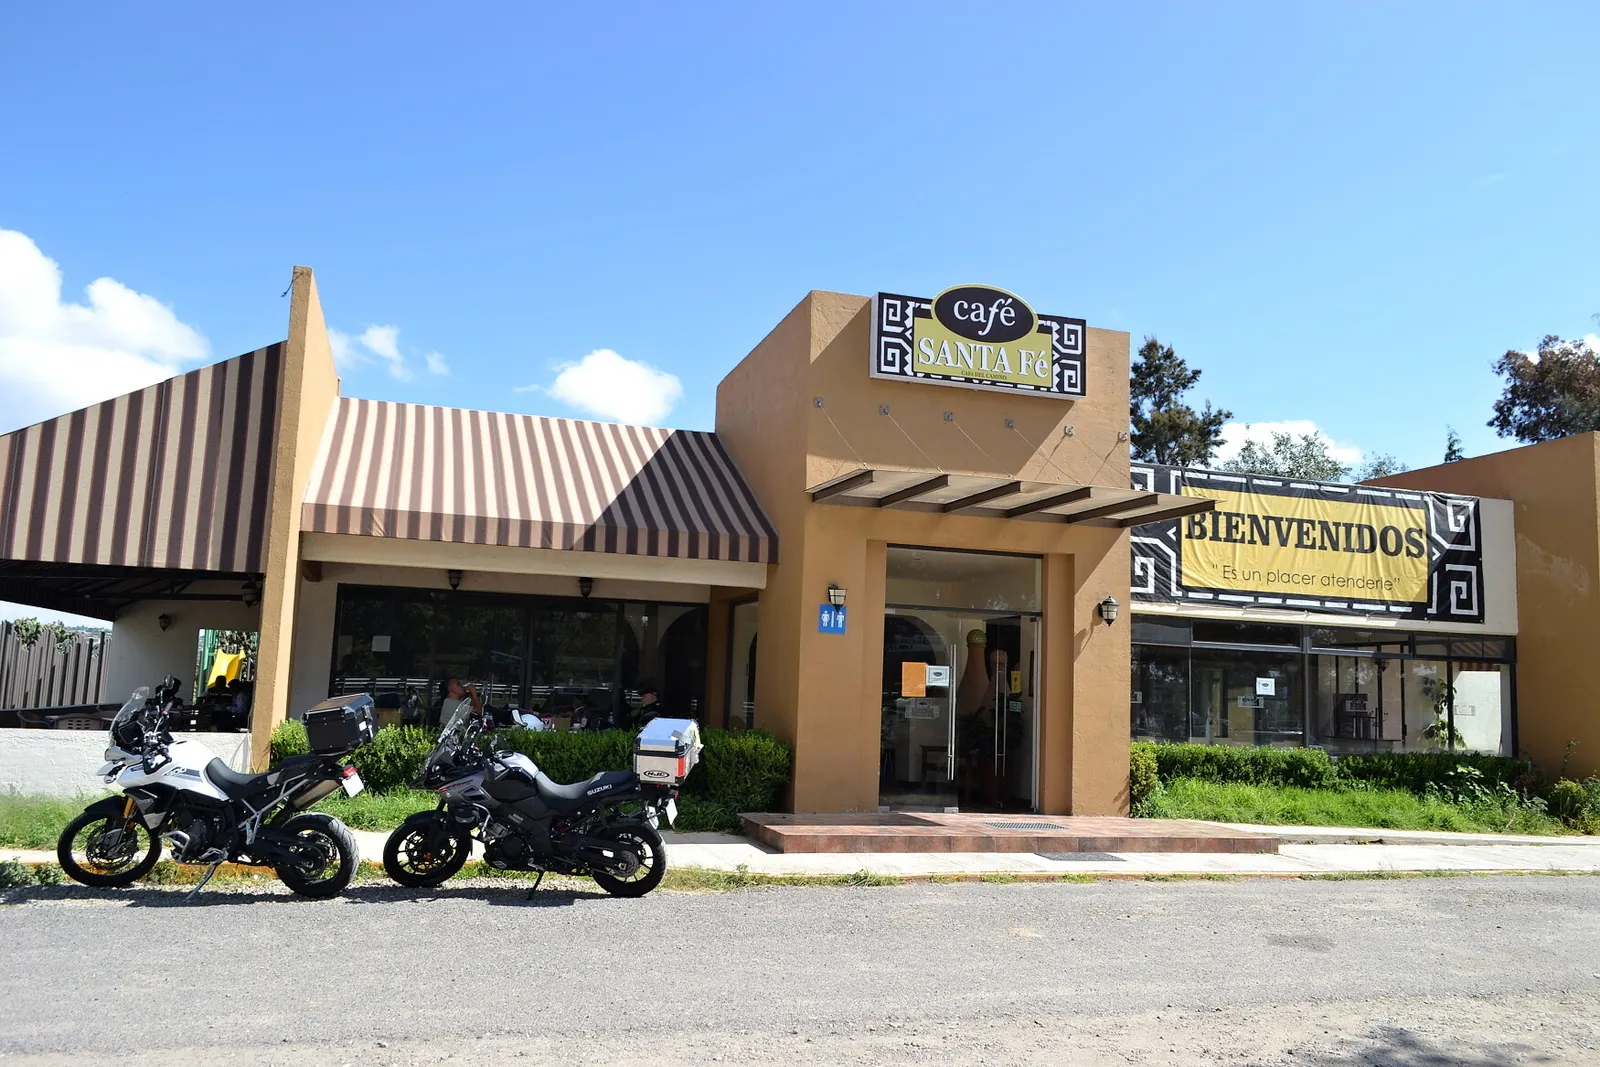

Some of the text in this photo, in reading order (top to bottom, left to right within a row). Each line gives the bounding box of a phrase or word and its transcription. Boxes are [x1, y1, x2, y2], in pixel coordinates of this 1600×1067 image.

[953, 298, 1016, 336] café
[918, 337, 1049, 378] SANTA Fé
[1185, 510, 1425, 558] BIENVENIDOS
[1242, 569, 1261, 581] un
[1267, 569, 1316, 585] placer
[587, 784, 613, 796] SUZUKI
